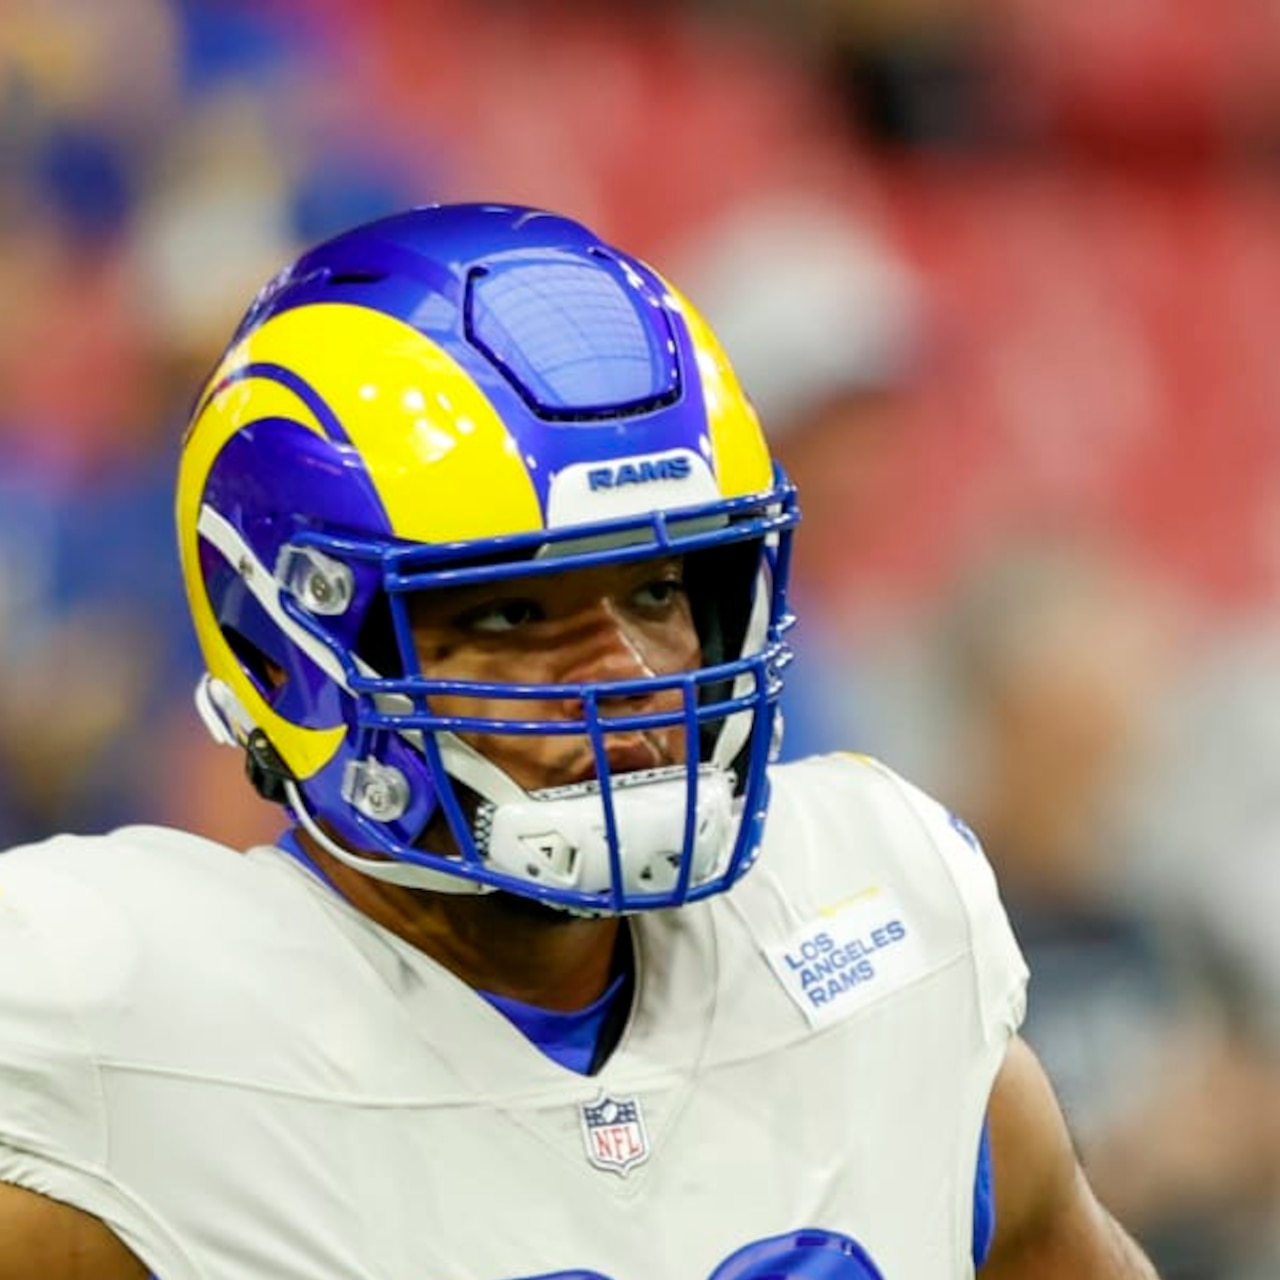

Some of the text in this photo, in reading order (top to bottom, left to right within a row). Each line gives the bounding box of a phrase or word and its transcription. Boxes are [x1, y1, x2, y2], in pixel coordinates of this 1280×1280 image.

[587, 457, 691, 492] RAMS
[784, 932, 835, 970] LOS
[800, 920, 906, 990] ANGELES
[807, 959, 875, 1008] RAMS
[594, 1126, 640, 1160] NFL
